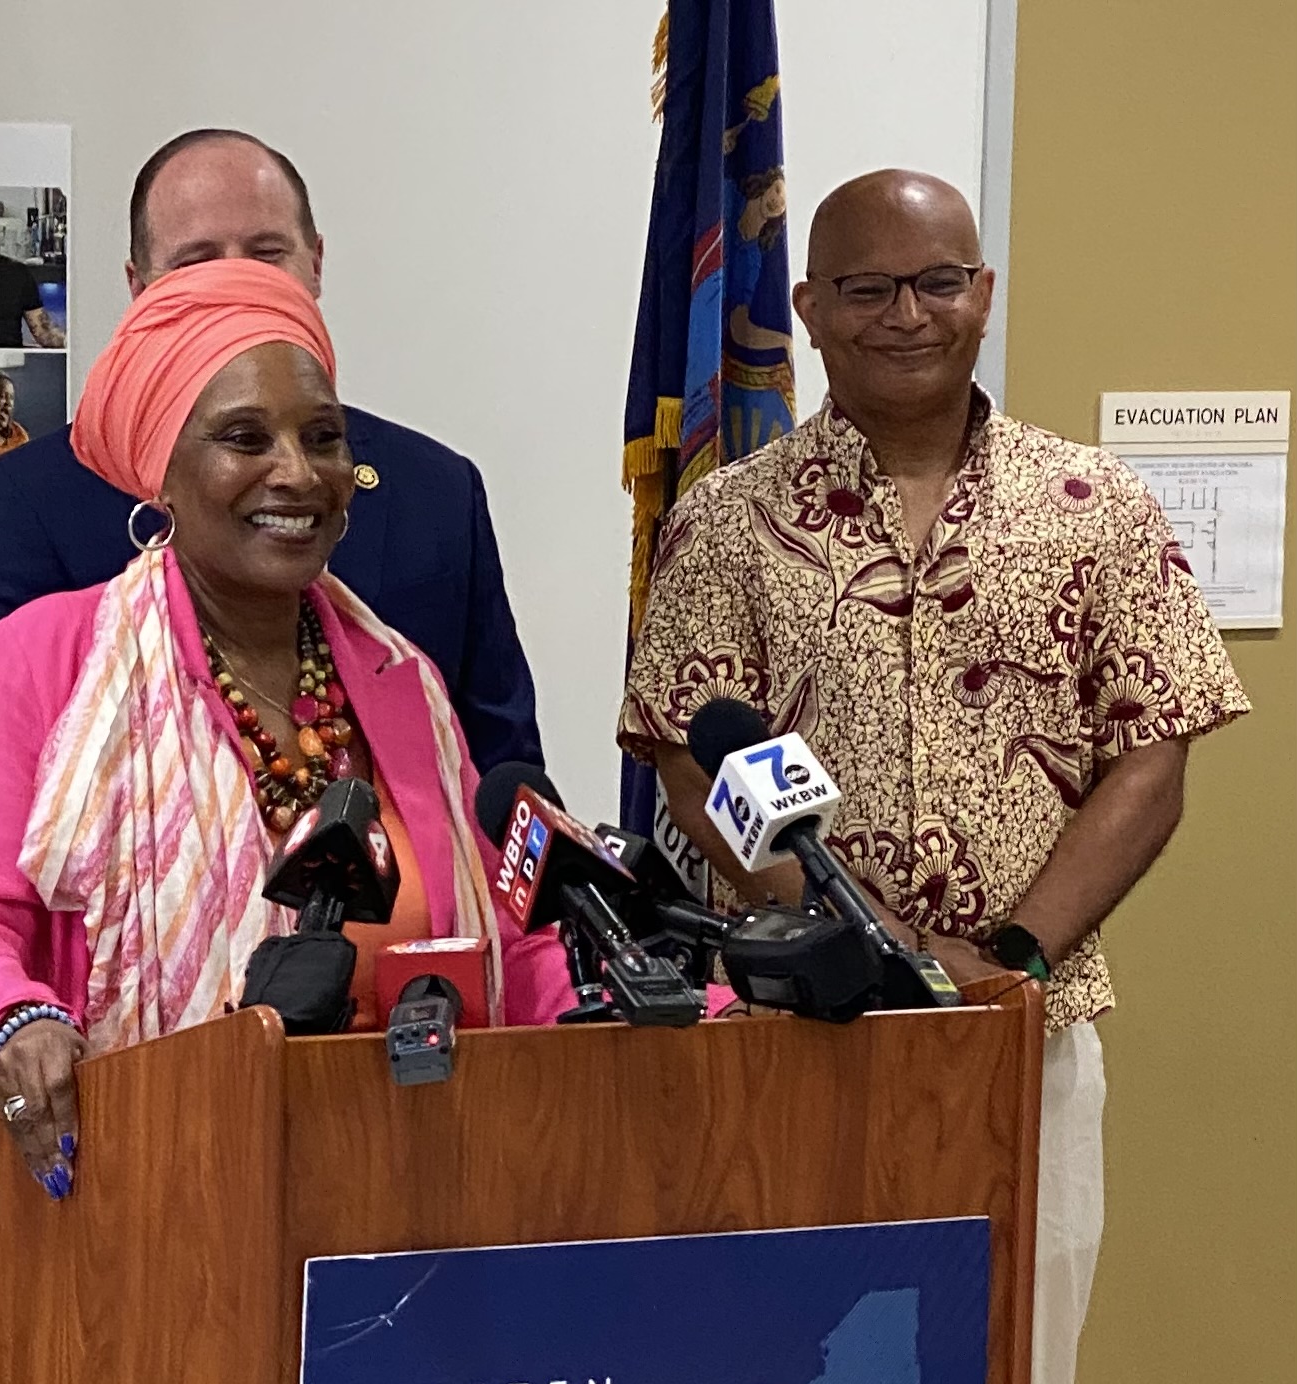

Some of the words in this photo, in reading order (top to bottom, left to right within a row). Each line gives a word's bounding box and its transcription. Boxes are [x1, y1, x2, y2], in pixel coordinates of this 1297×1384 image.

[1115, 408, 1225, 425] EVACUATION
[1234, 407, 1279, 424] PLAN
[744, 744, 792, 792] 7
[712, 776, 745, 836] 7
[770, 784, 828, 811] WKBW
[496, 800, 530, 893] WBFO
[741, 810, 764, 860] WKBW
[515, 828, 541, 908] npr
